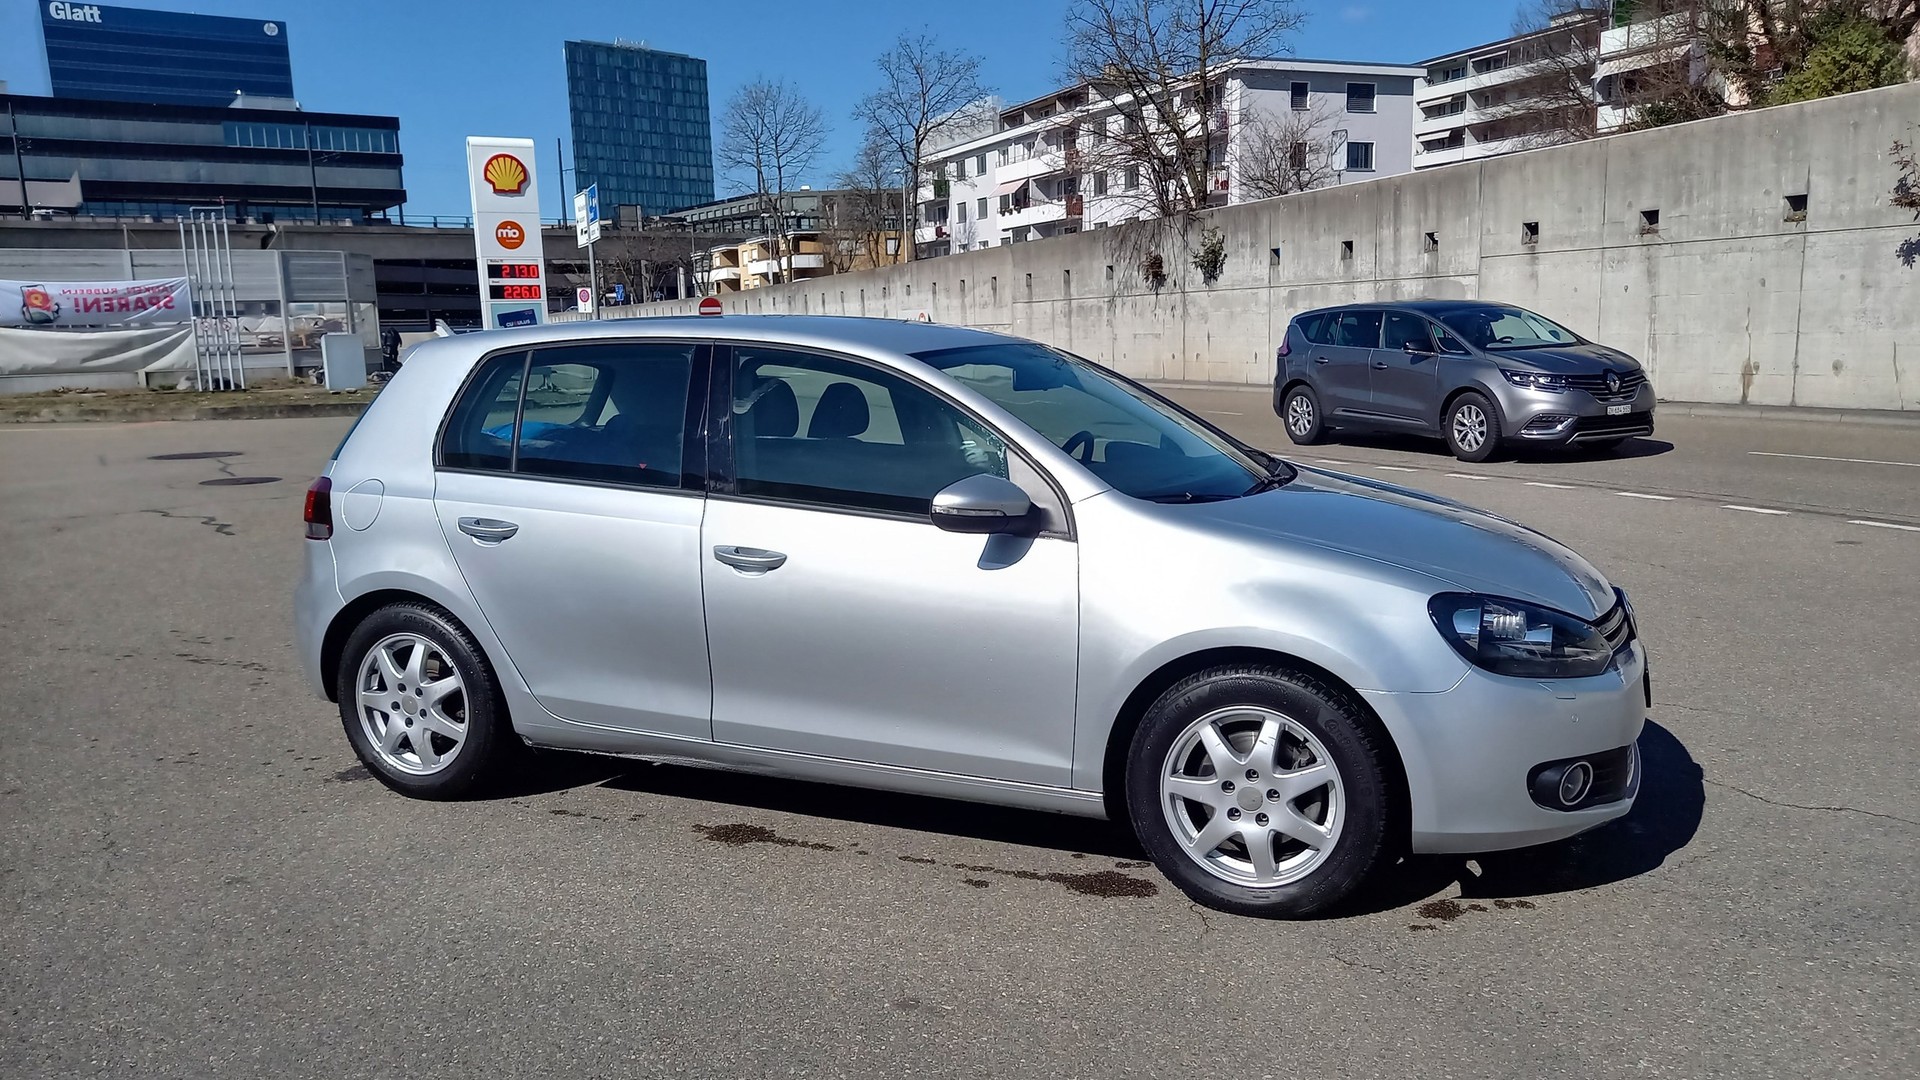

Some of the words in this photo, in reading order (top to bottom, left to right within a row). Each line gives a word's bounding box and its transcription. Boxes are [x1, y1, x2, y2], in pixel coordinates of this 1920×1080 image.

[49, 1, 102, 23] Glatt
[502, 265, 538, 278] 213.0
[504, 286, 540, 299] 226.0
